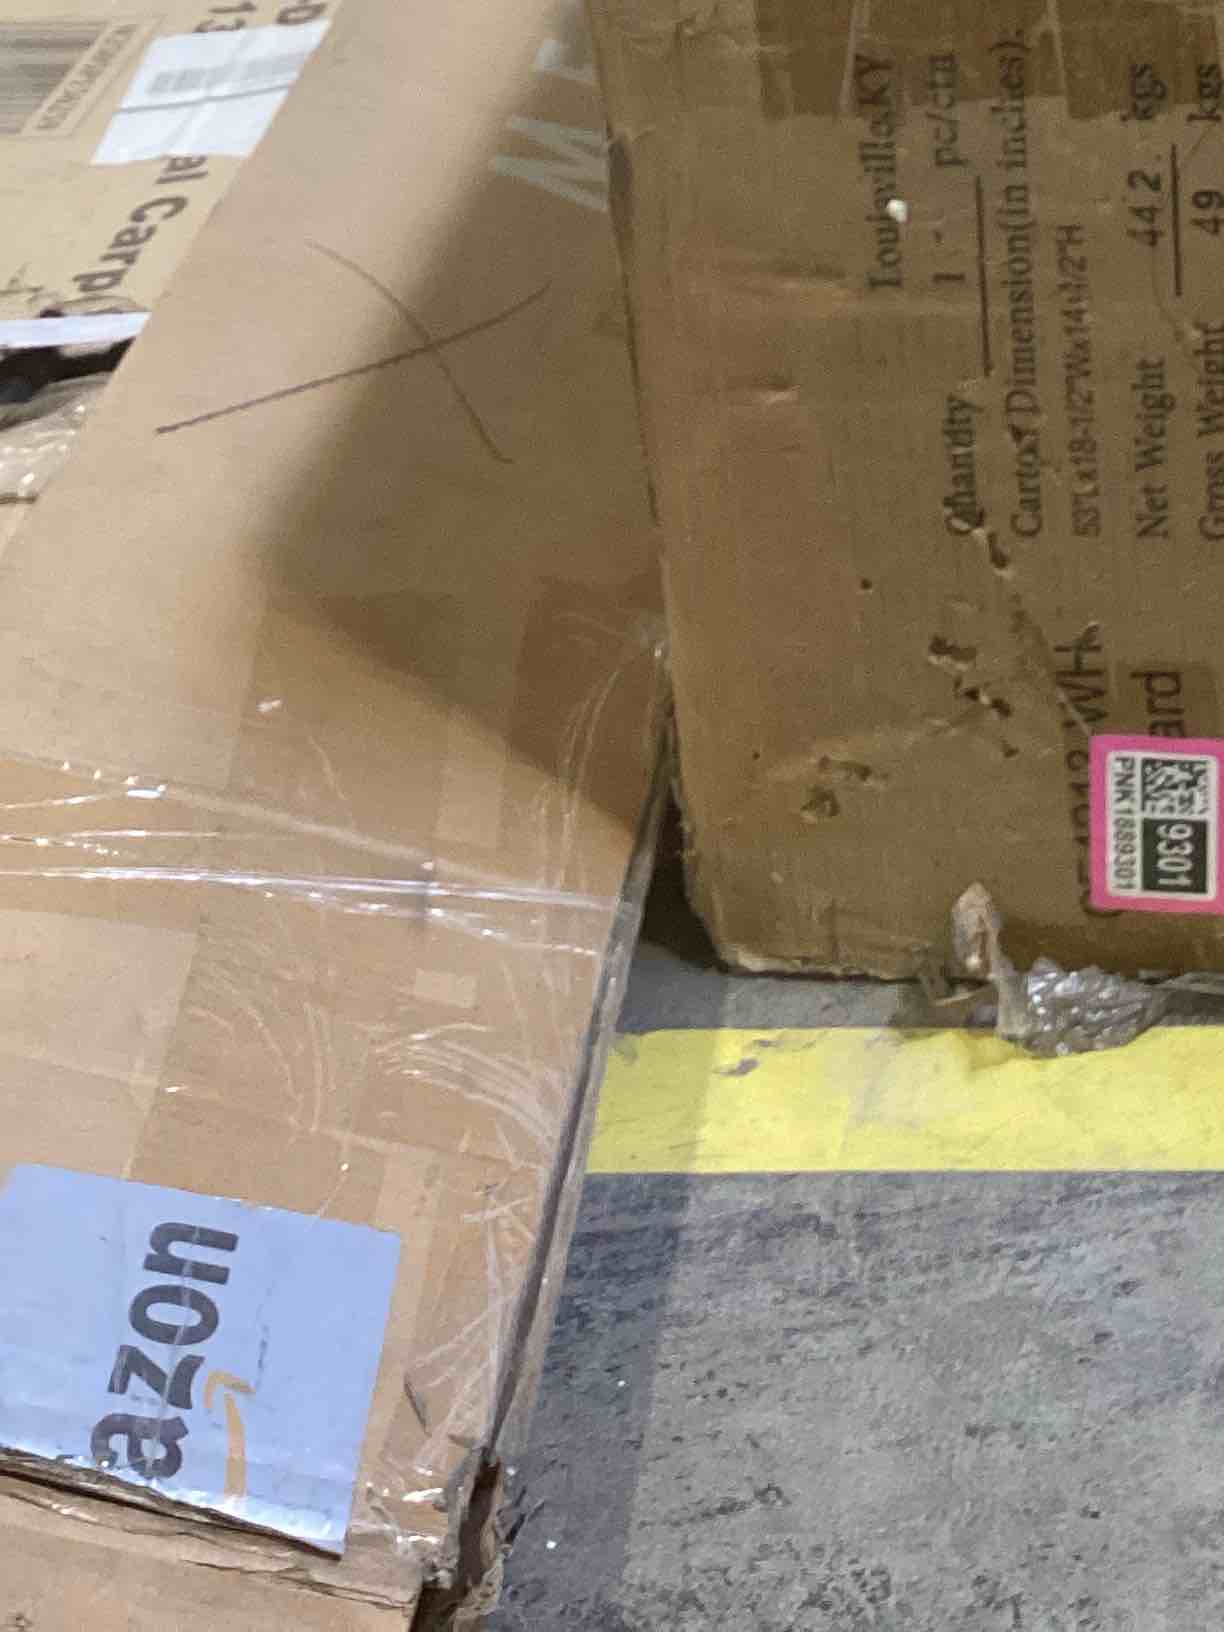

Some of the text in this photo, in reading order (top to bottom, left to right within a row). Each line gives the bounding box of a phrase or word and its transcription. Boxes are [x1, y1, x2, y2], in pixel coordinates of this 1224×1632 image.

[1120, 62, 1167, 122] kgs
[72, 195, 189, 293] Carp
[1129, 355, 1176, 471] Weight
[1135, 483, 1170, 541] Net
[1112, 756, 1137, 891] PNK1889301
[1154, 822, 1193, 888] 9301
